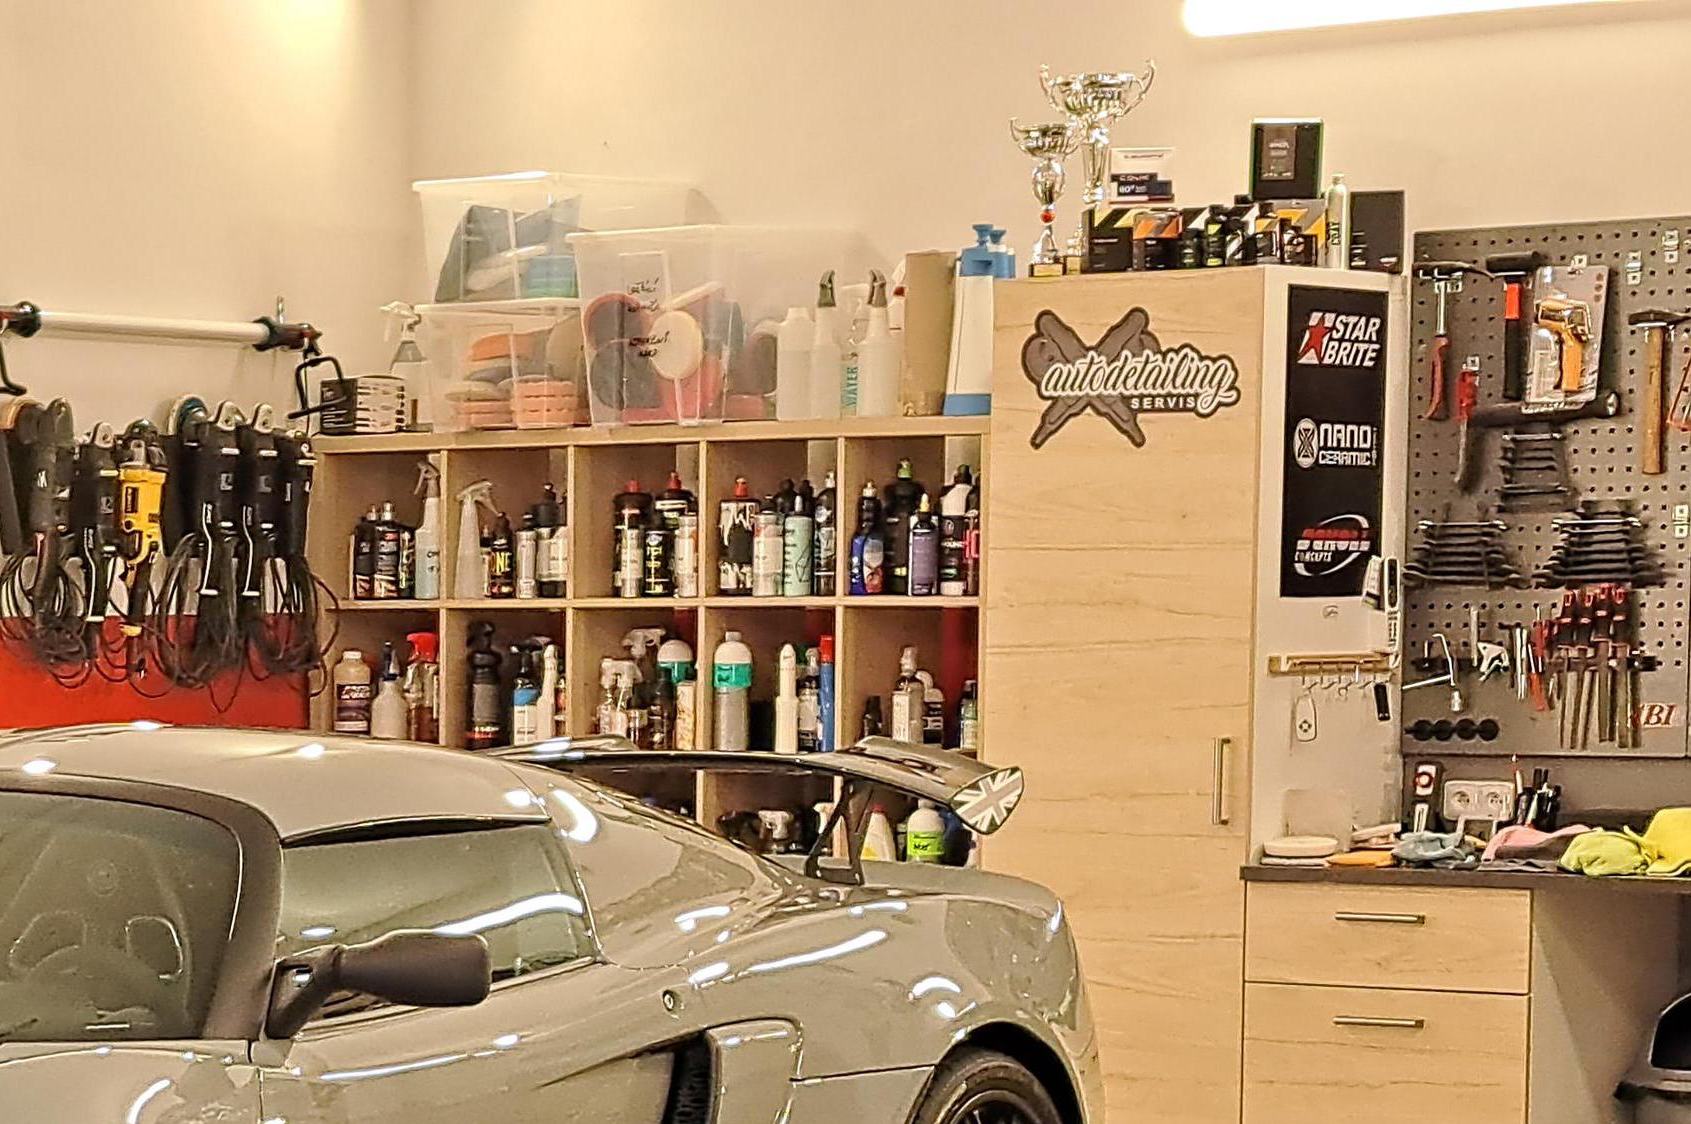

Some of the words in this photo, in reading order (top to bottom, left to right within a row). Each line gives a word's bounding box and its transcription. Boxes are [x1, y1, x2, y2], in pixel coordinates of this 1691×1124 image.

[1332, 315, 1381, 341] STAR
[1321, 341, 1381, 367] BRITE
[1042, 350, 1238, 413] autodetailing
[1130, 397, 1196, 409] SERVIS
[1319, 422, 1372, 449] NANO
[1318, 450, 1372, 467] CERAMIC
